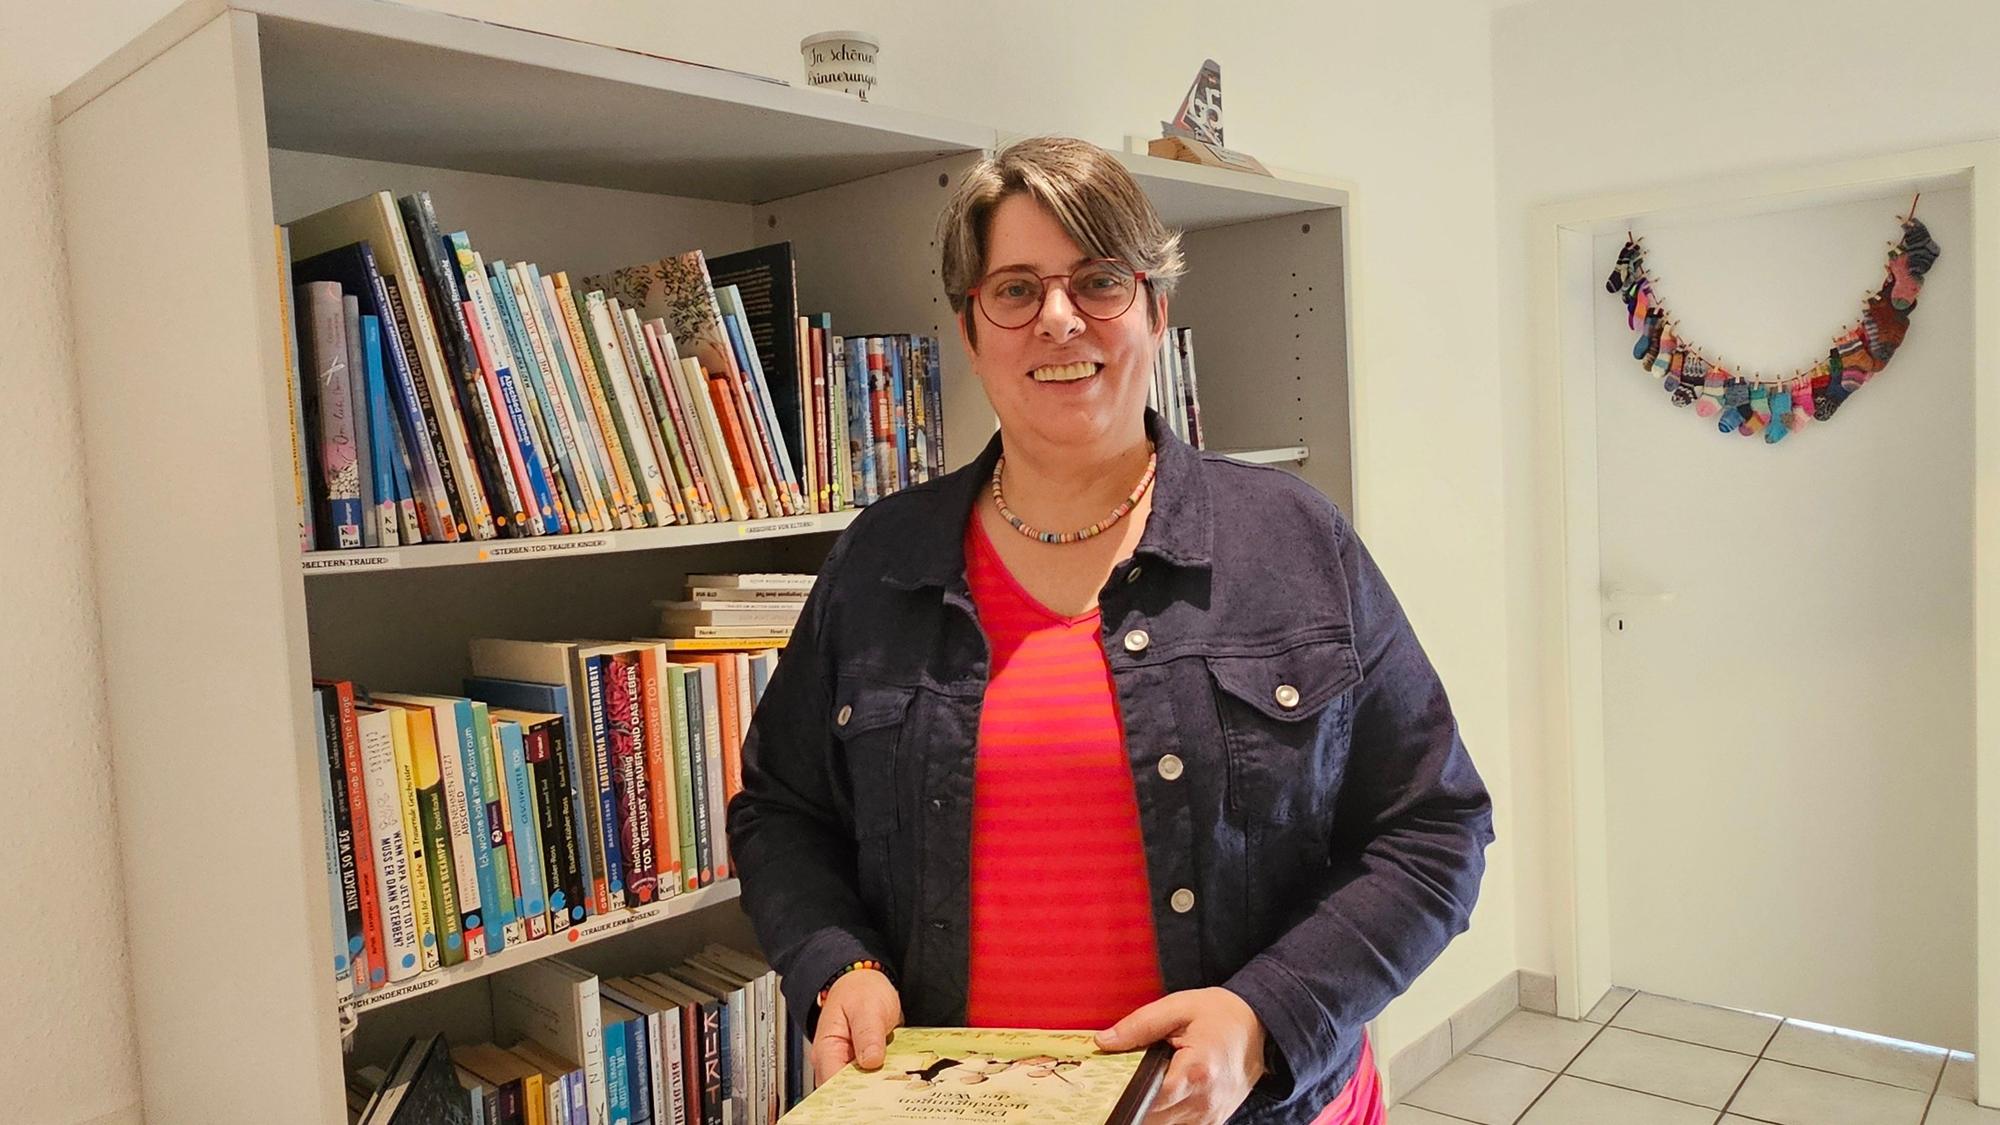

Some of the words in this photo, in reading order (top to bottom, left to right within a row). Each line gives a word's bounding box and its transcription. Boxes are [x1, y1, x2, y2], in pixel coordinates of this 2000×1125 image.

[386, 284, 405, 321] UNTEN
[397, 321, 412, 347] VON
[405, 347, 432, 410] RADIESCHEN
[502, 373, 522, 413] Abschied
[515, 413, 532, 446] nehmen
[903, 389, 917, 440] RATATOUILLE
[626, 665, 637, 700] LEBEN
[646, 677, 657, 702] TOD
[341, 695, 353, 723] Frage
[588, 664, 604, 735] TRAUERARBEIT
[629, 702, 639, 724] DAS
[631, 726, 642, 750] UND
[648, 706, 662, 763] Schwester
[463, 726, 478, 785] Zeitlosraum
[596, 736, 610, 792] TABUTHEMA
[633, 751, 645, 792] TRAUER
[443, 779, 461, 820] NEHMEN
[471, 785, 479, 797] im
[453, 790, 472, 836] ABSCHIED
[472, 797, 482, 819] bald
[338, 829, 351, 854] WEG
[408, 808, 419, 844] Trauernde
[451, 819, 462, 838] WIR
[475, 819, 487, 851] wohne
[379, 837, 392, 863] MUSS
[392, 830, 403, 856] WENN
[565, 840, 576, 874] Elisabeth
[341, 854, 352, 867] SO
[384, 864, 394, 876] ER
[396, 858, 407, 881] PAPA
[478, 852, 488, 868] Ich
[342, 869, 357, 910] EINFACH
[385, 878, 398, 902] DANN
[399, 883, 410, 910] JETZT
[441, 881, 454, 914] RIESEN
[388, 904, 404, 947] STERBEN?
[403, 912, 413, 929] TOT
[587, 1027, 600, 1085] NILS
[703, 1010, 721, 1104] KURT
